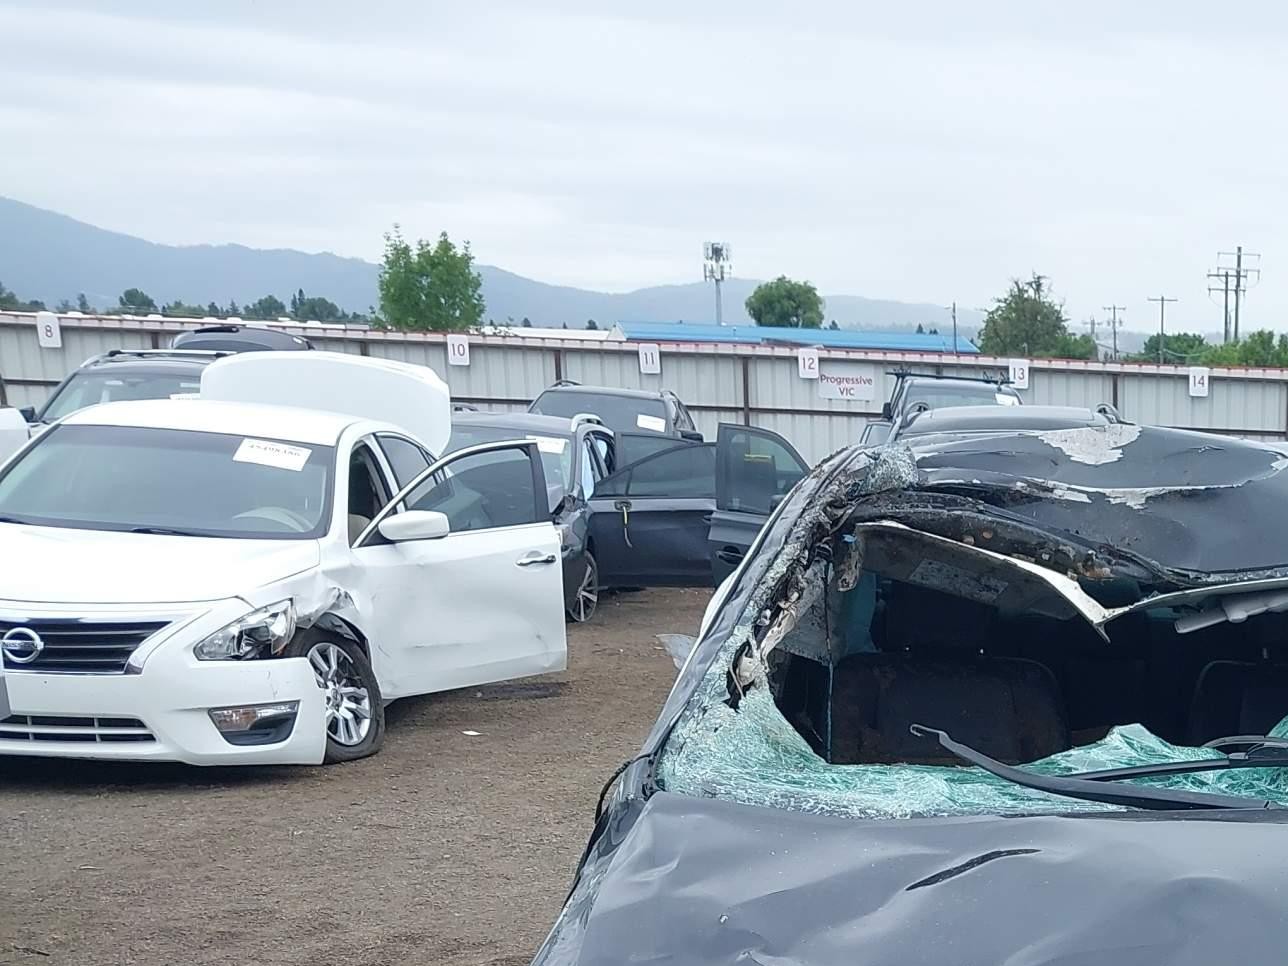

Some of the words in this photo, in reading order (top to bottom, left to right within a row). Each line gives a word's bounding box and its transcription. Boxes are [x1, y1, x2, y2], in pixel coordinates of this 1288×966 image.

[44, 324, 54, 339] 8
[451, 342, 466, 357] 10
[644, 351, 655, 365] 11
[802, 357, 815, 370] 12
[820, 374, 873, 386] Progressive
[1013, 367, 1026, 380] 13
[1193, 375, 1206, 388] 14
[838, 387, 855, 396] VIC
